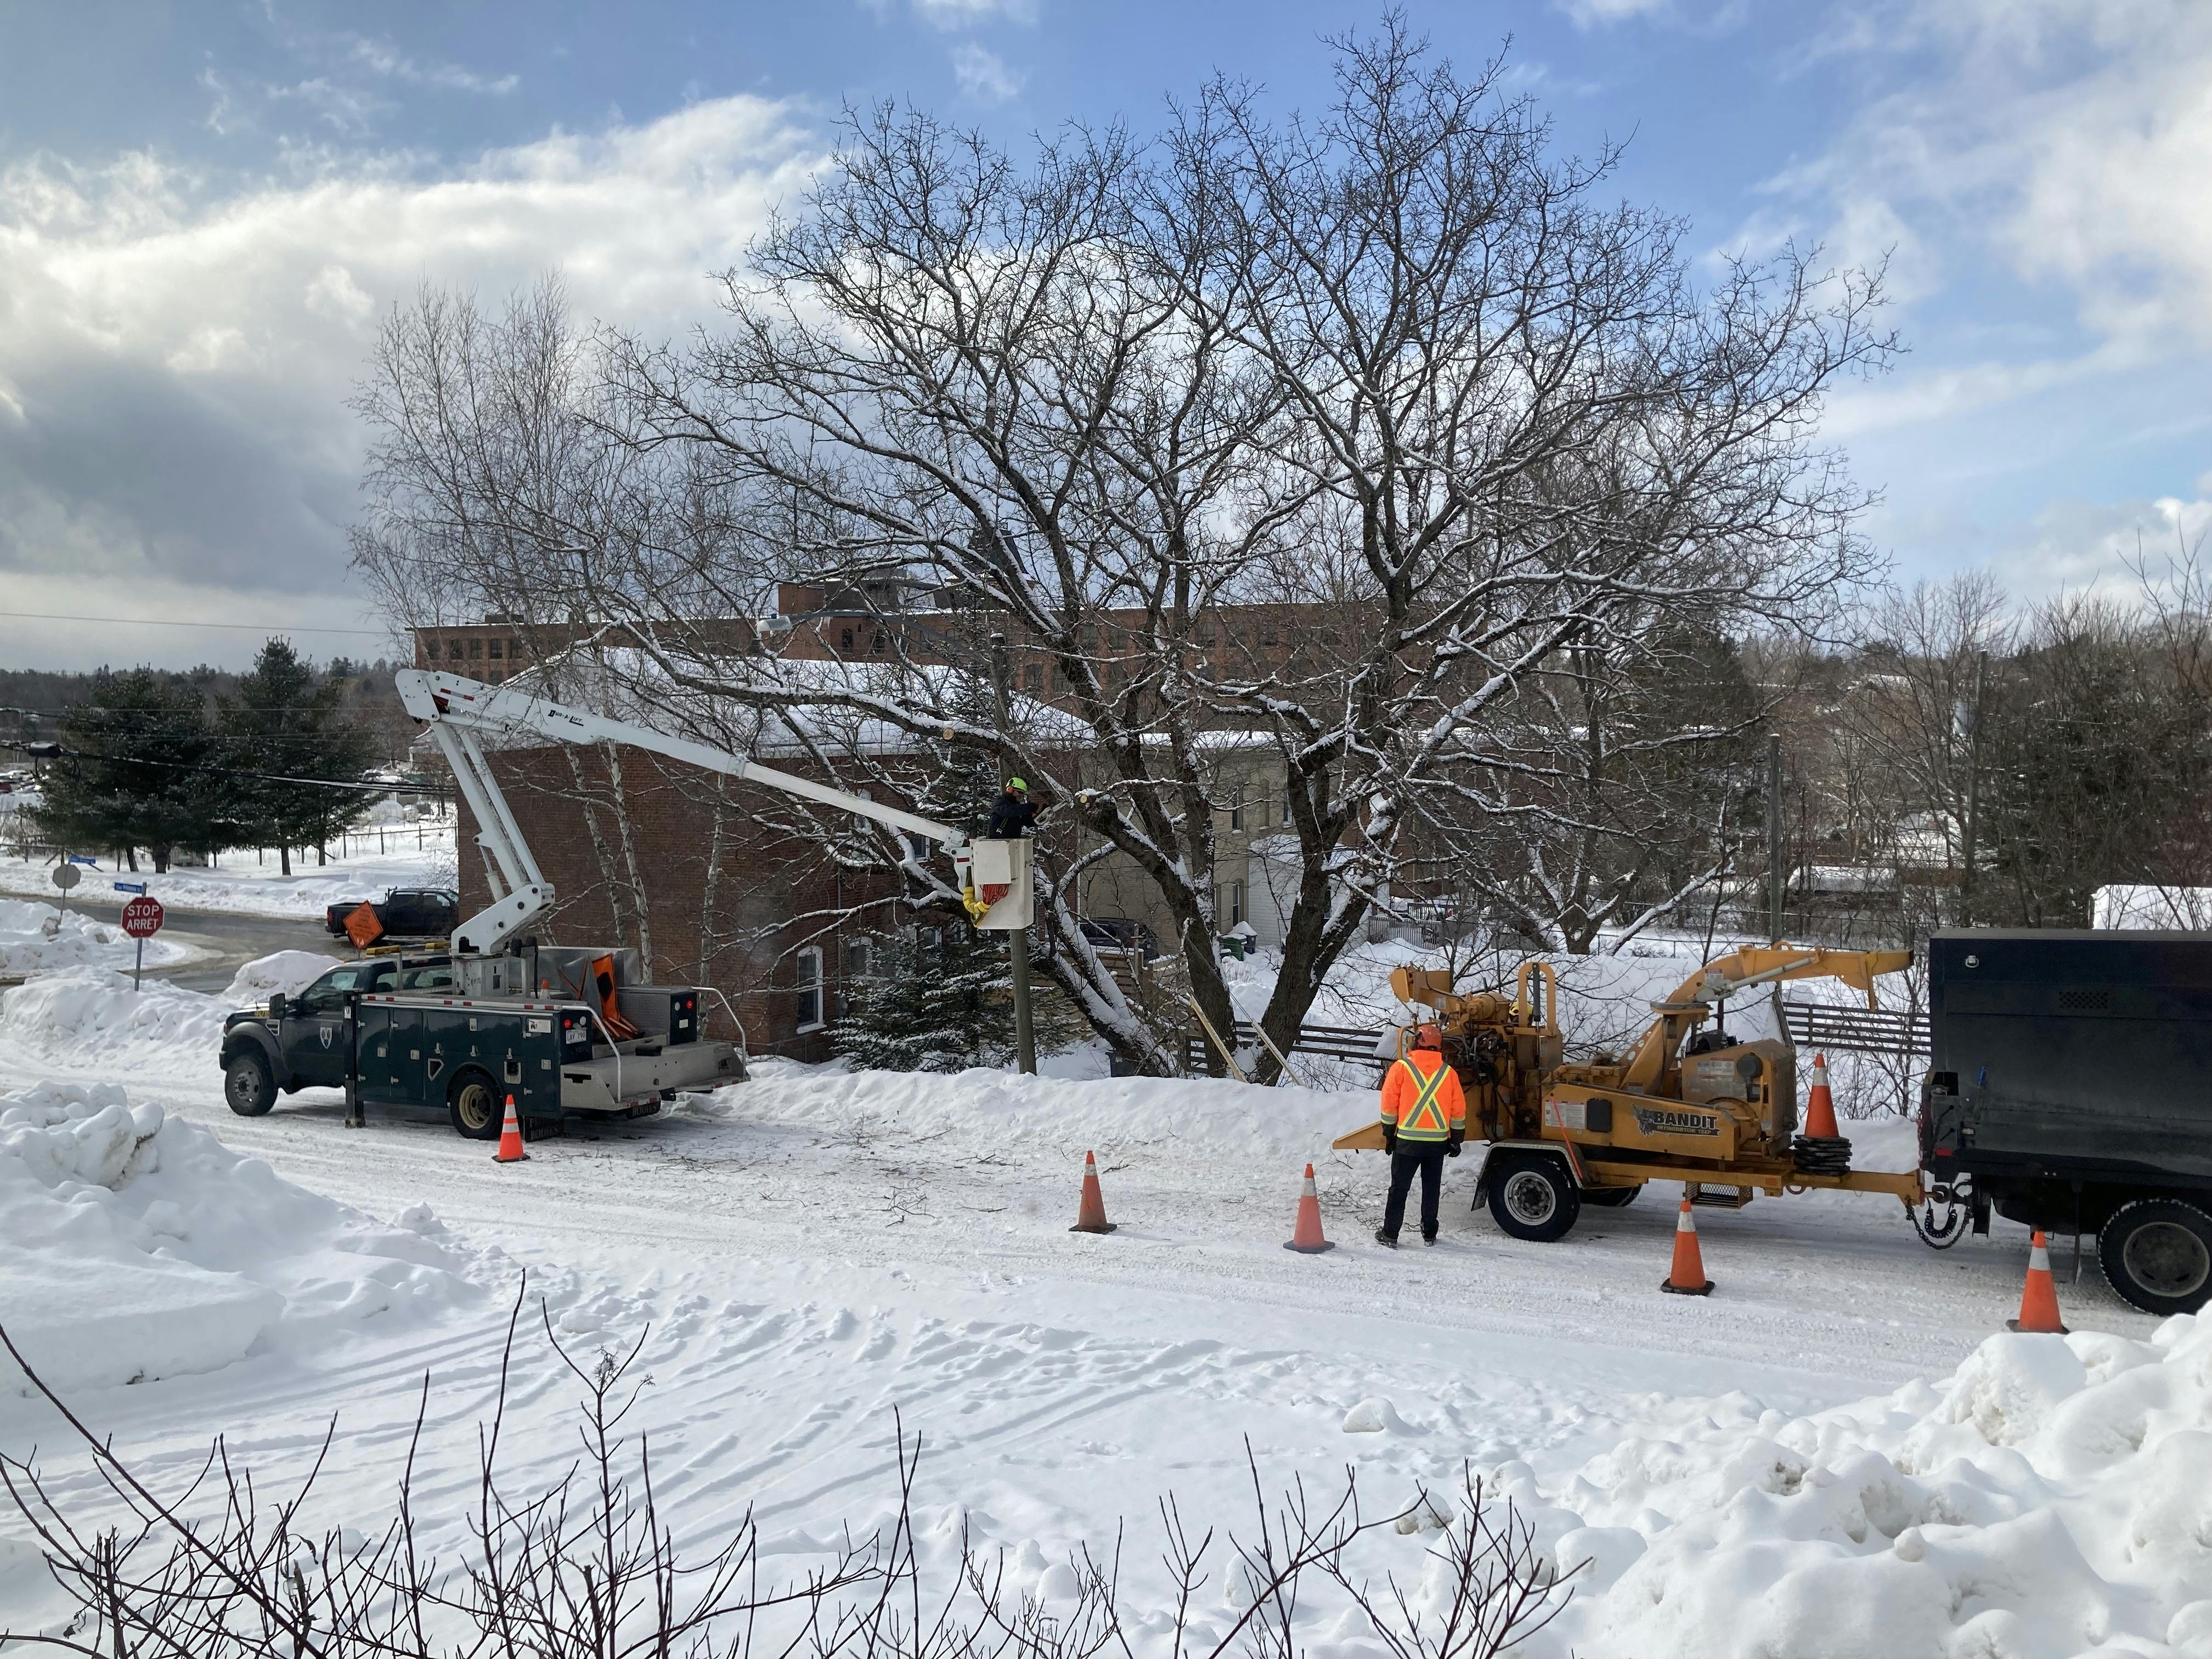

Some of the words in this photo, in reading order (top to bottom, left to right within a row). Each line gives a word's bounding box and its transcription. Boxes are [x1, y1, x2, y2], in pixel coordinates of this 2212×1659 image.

[548, 709, 584, 726] DUR-A-LIFT
[128, 905, 159, 917] STOP
[127, 918, 159, 930] ARRÊT
[1654, 1111, 1717, 1128] BANDIT
